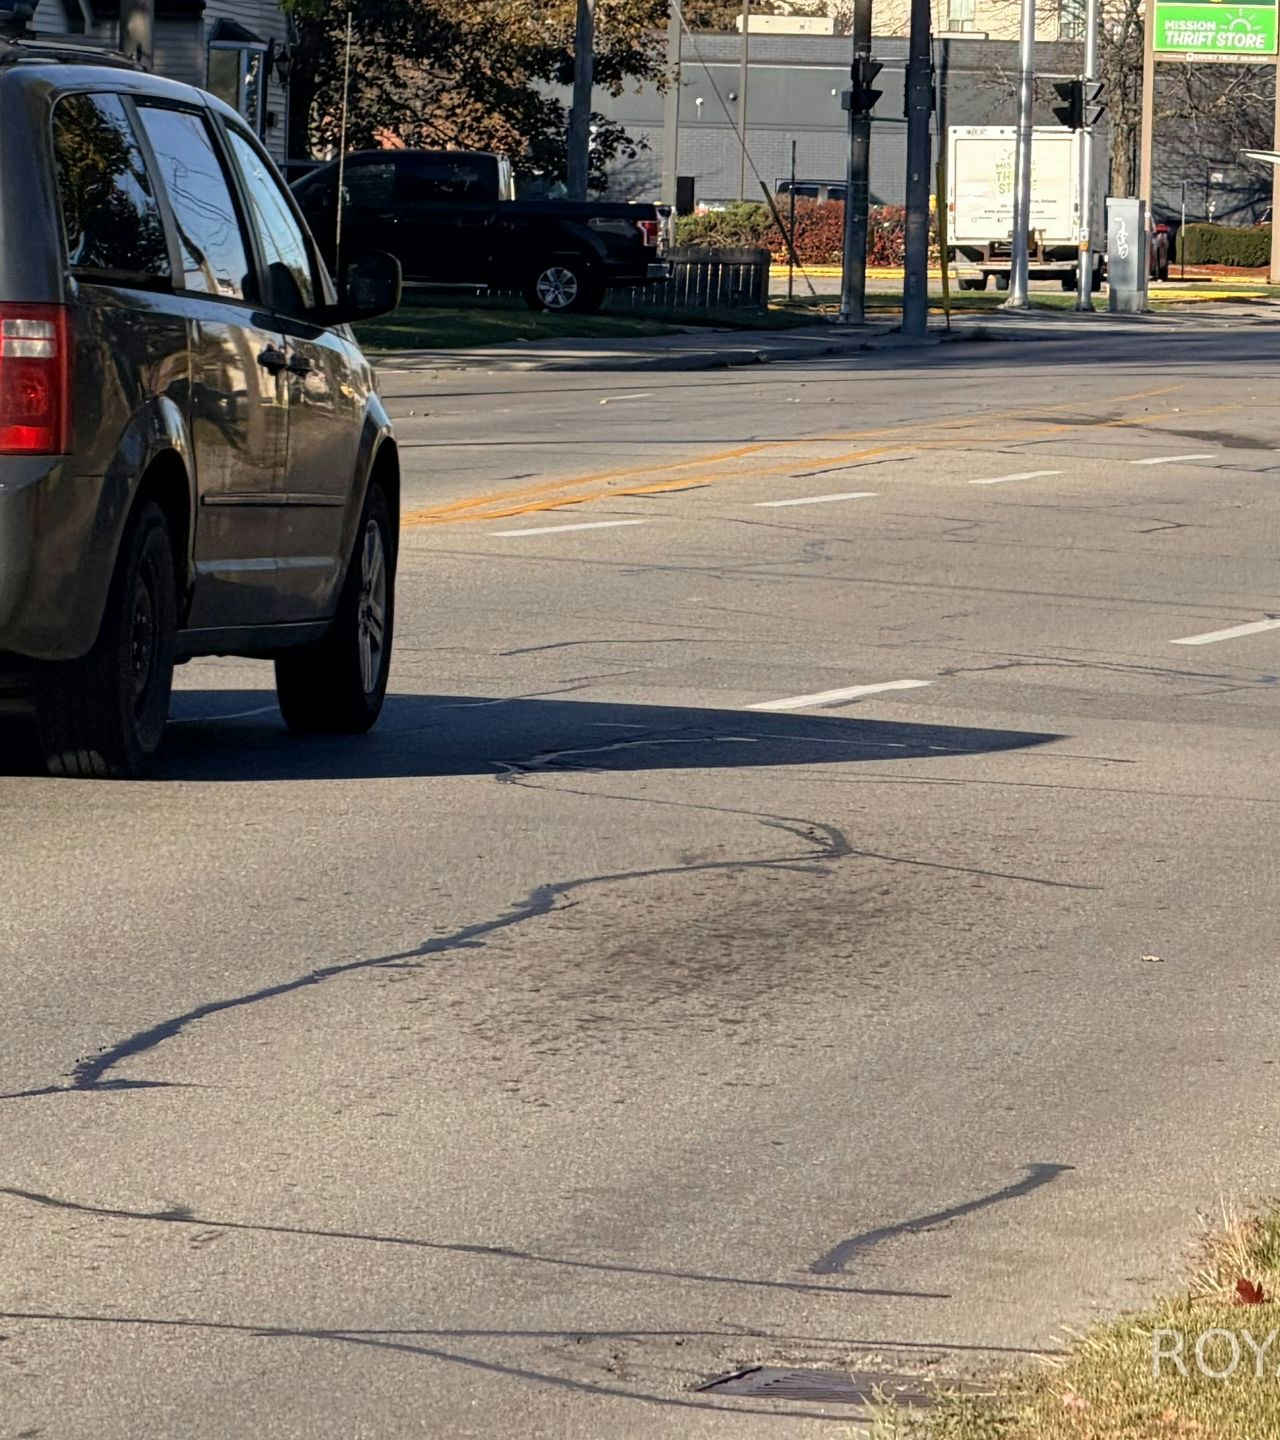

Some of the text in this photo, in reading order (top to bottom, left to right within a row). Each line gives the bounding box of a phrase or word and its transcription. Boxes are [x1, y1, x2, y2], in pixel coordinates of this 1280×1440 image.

[1164, 20, 1217, 31] MISSION
[1165, 31, 1266, 49] THRIFT STORE
